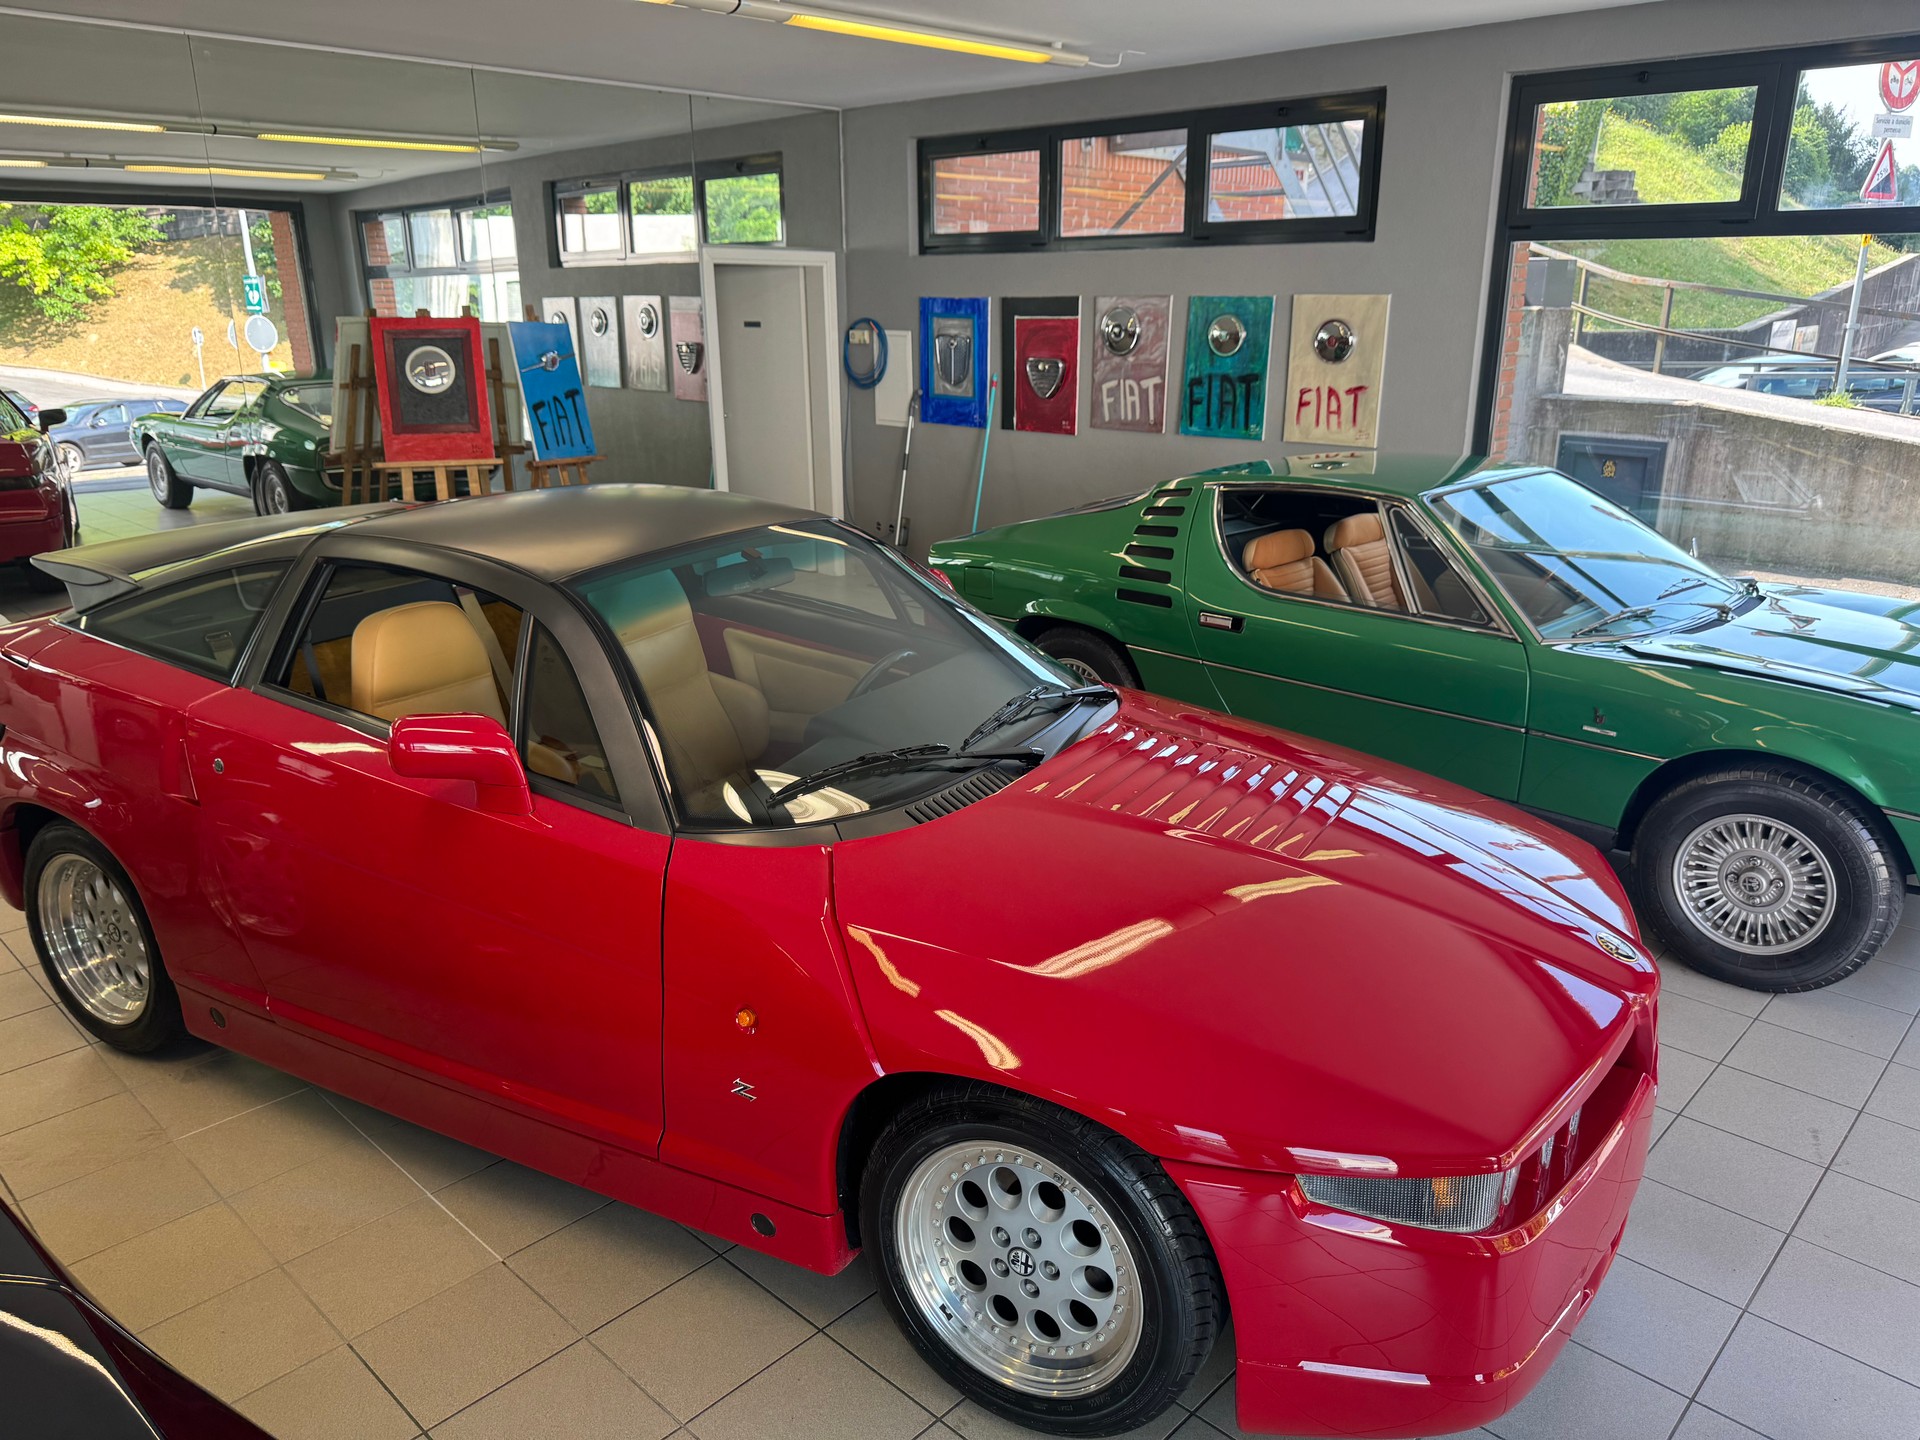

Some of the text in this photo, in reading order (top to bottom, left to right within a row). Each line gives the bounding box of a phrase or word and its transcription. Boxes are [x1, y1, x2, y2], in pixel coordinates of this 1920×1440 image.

[532, 388, 587, 451] FIAT
[1102, 375, 1163, 425] FIAT
[1188, 373, 1260, 431] FIAT
[1296, 385, 1370, 430] FIAT
